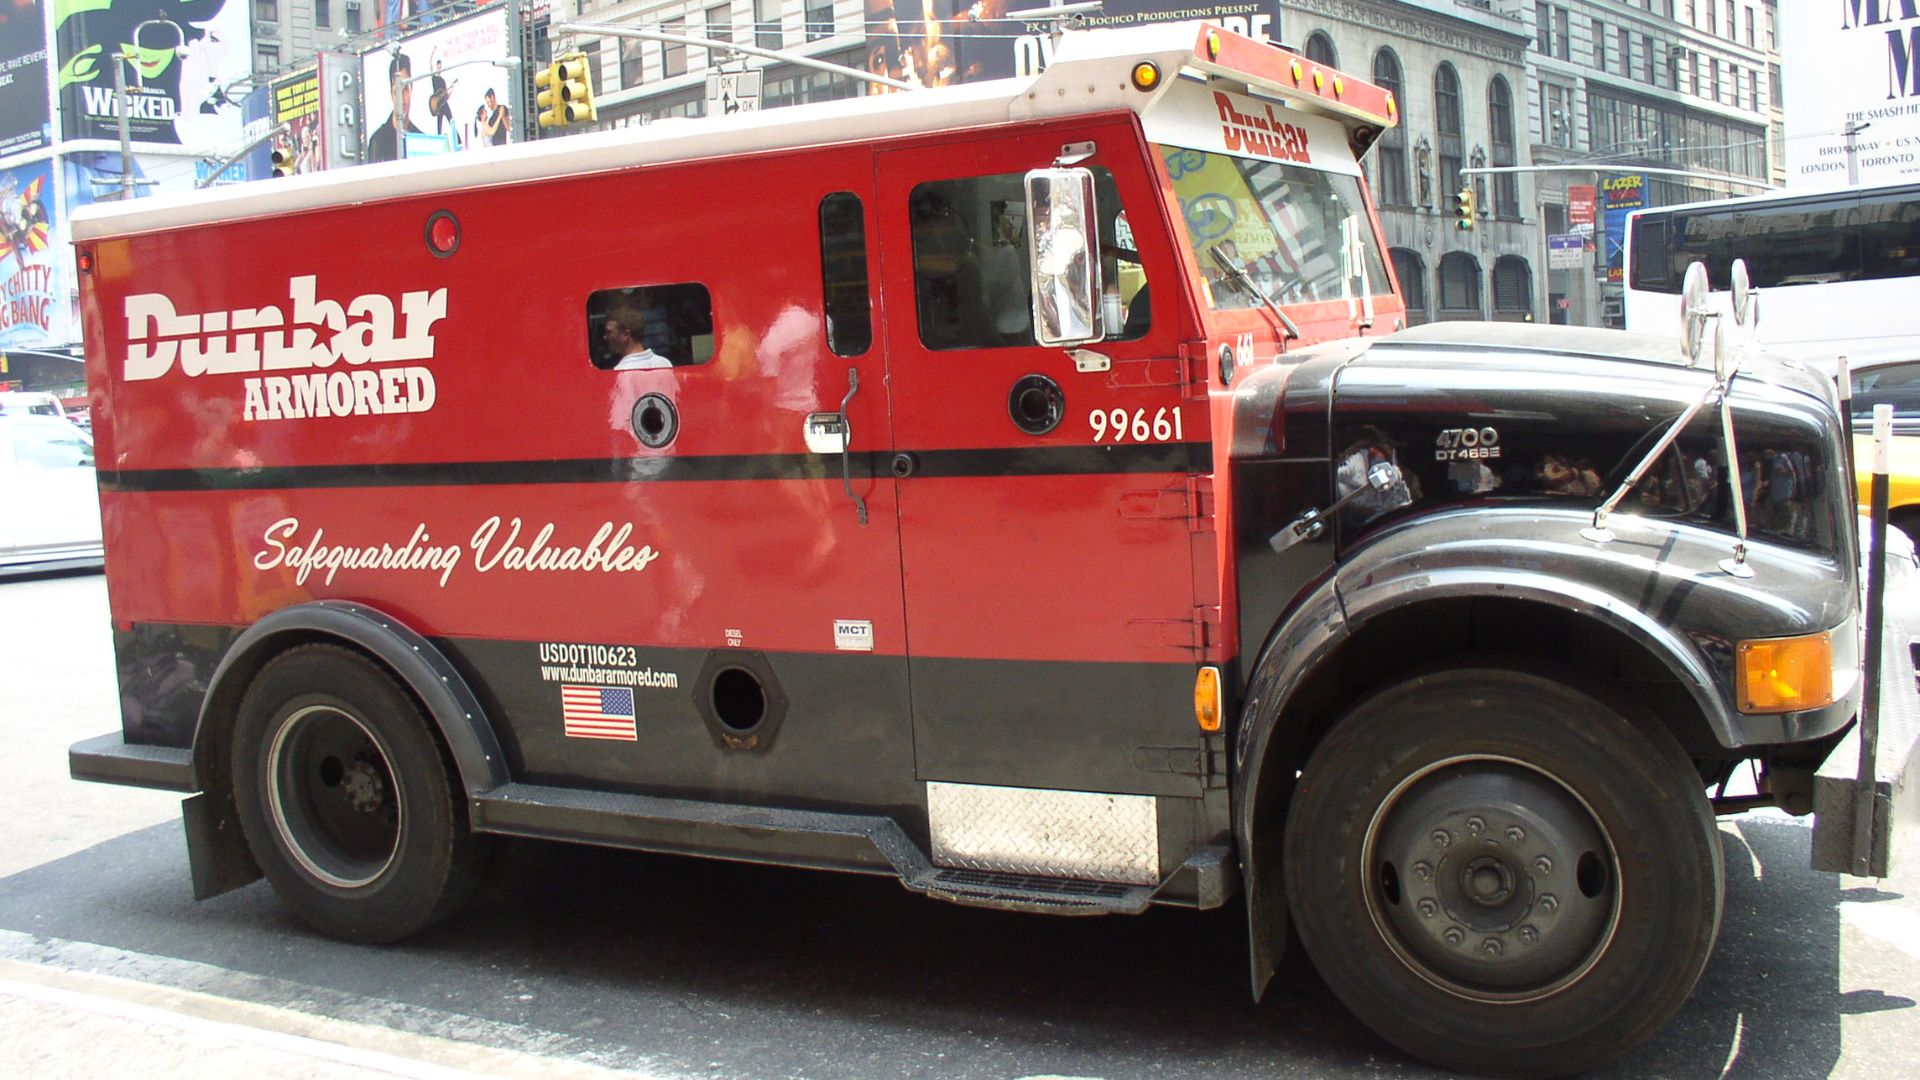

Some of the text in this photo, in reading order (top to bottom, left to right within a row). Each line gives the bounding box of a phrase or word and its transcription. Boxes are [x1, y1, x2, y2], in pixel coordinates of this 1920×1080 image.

[1089, 14, 1134, 27] BOCHCO
[1137, 7, 1212, 20] PRODUCTIONS
[1214, 3, 1260, 15] PRESENT
[721, 78, 732, 89] OK
[743, 100, 754, 112] OK
[1847, 111, 1865, 121] THE
[1868, 106, 1903, 120] SMASH
[1214, 92, 1311, 164] Dunbar
[1819, 141, 1880, 156] BROWAY
[1896, 138, 1910, 148] US
[1801, 153, 1914, 175] LONDON TORONTO
[1603, 176, 1643, 190] LAZER
[8, 265, 51, 296] CHITTY
[11, 295, 50, 331] BANG
[124, 274, 447, 382] Dunbar
[243, 366, 436, 421] ARMORED
[1089, 406, 1183, 443] 99661
[1436, 426, 1498, 448] 4700
[254, 515, 659, 587] Safeguarding Valuables
[838, 626, 868, 635] MCT
[540, 643, 637, 667] USDOT110623
[541, 664, 679, 689] www.dunbararmored.com
